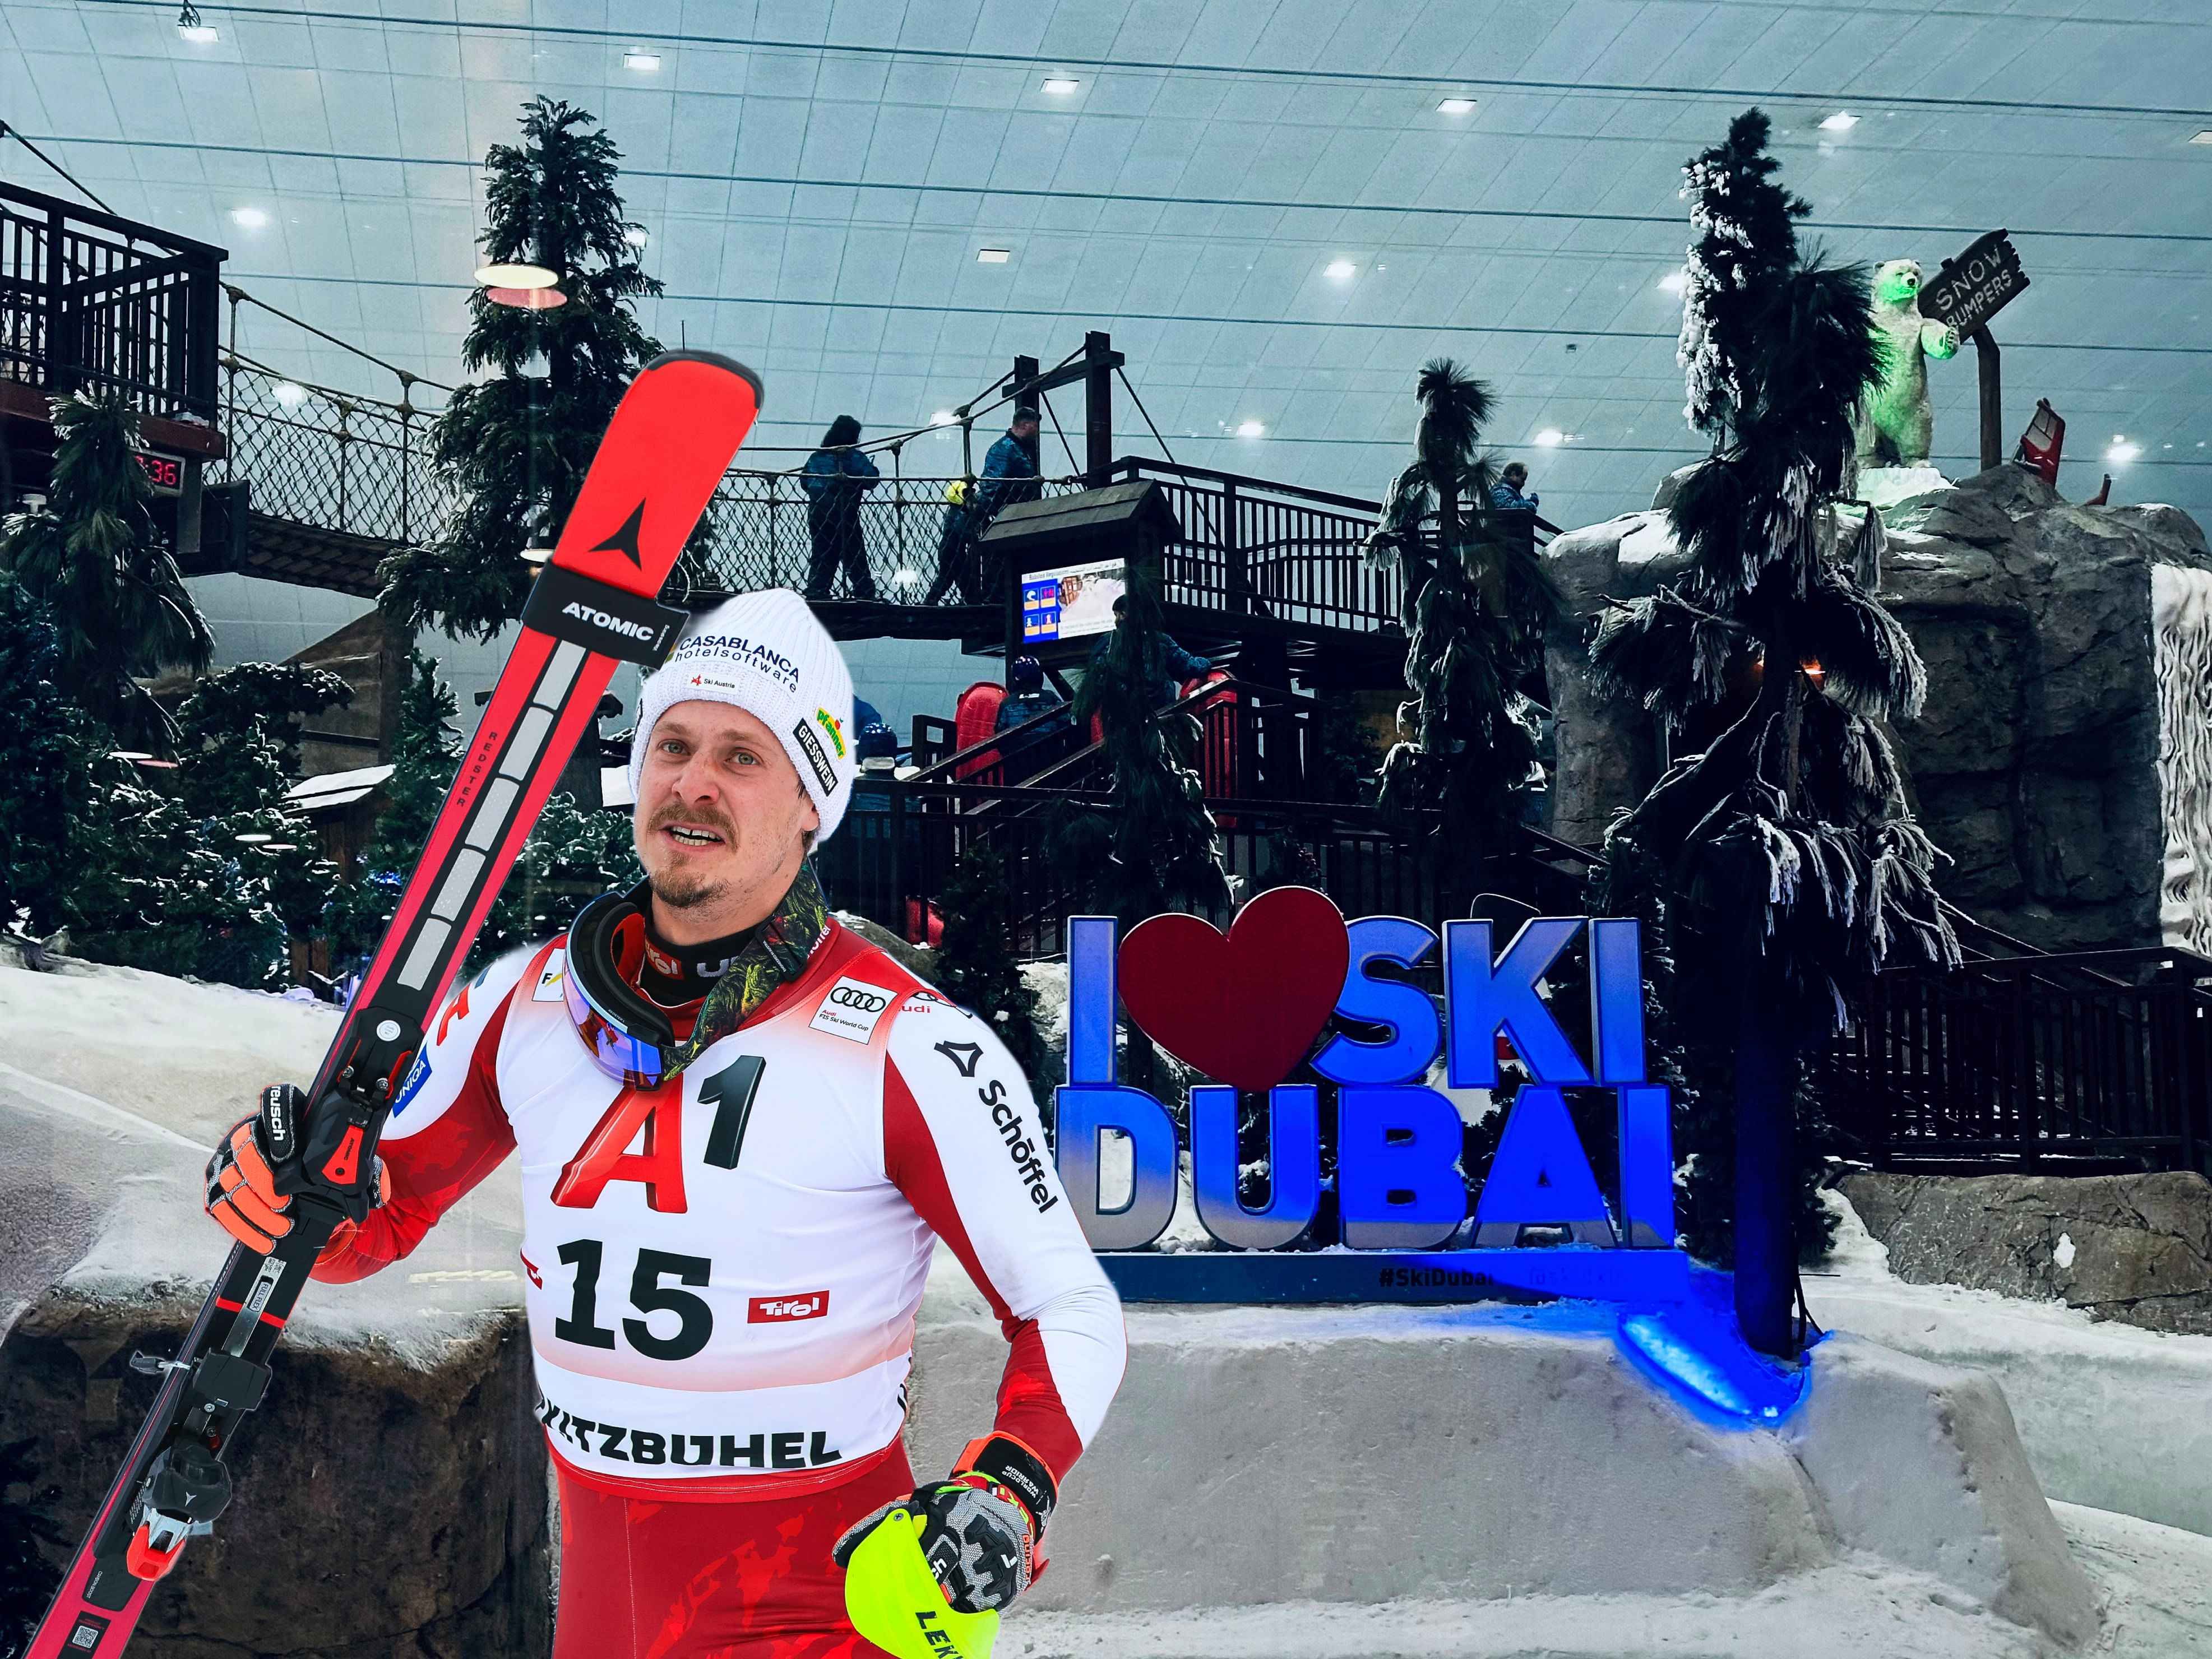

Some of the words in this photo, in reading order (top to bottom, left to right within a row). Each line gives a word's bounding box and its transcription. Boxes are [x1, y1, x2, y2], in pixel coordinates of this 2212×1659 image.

[1936, 244, 2001, 310] SNOW
[562, 601, 654, 641] ATOMIC
[675, 647, 797, 693] hotelsoftware
[679, 636, 799, 684] CASABLANCA
[714, 680, 735, 689] Austria
[817, 709, 844, 757] pfanner
[456, 731, 498, 807] REDSTER
[798, 725, 836, 791] GIESSWEIN
[840, 1019, 857, 1028] World
[1067, 915, 1118, 1087] I
[1309, 915, 1646, 1088] SKI
[270, 1086, 286, 1141] reusch
[549, 1055, 766, 1214] A1
[978, 1079, 1058, 1213] Schöffel
[1054, 1084, 1674, 1250] DUBAI
[252, 1296, 263, 1310] FLEX
[258, 1283, 269, 1297] FULL
[555, 1239, 713, 1361] 15
[760, 1297, 820, 1317] Tirol
[1005, 1465, 1039, 1495] WARRIOR
[1022, 1533, 1031, 1582] racing
